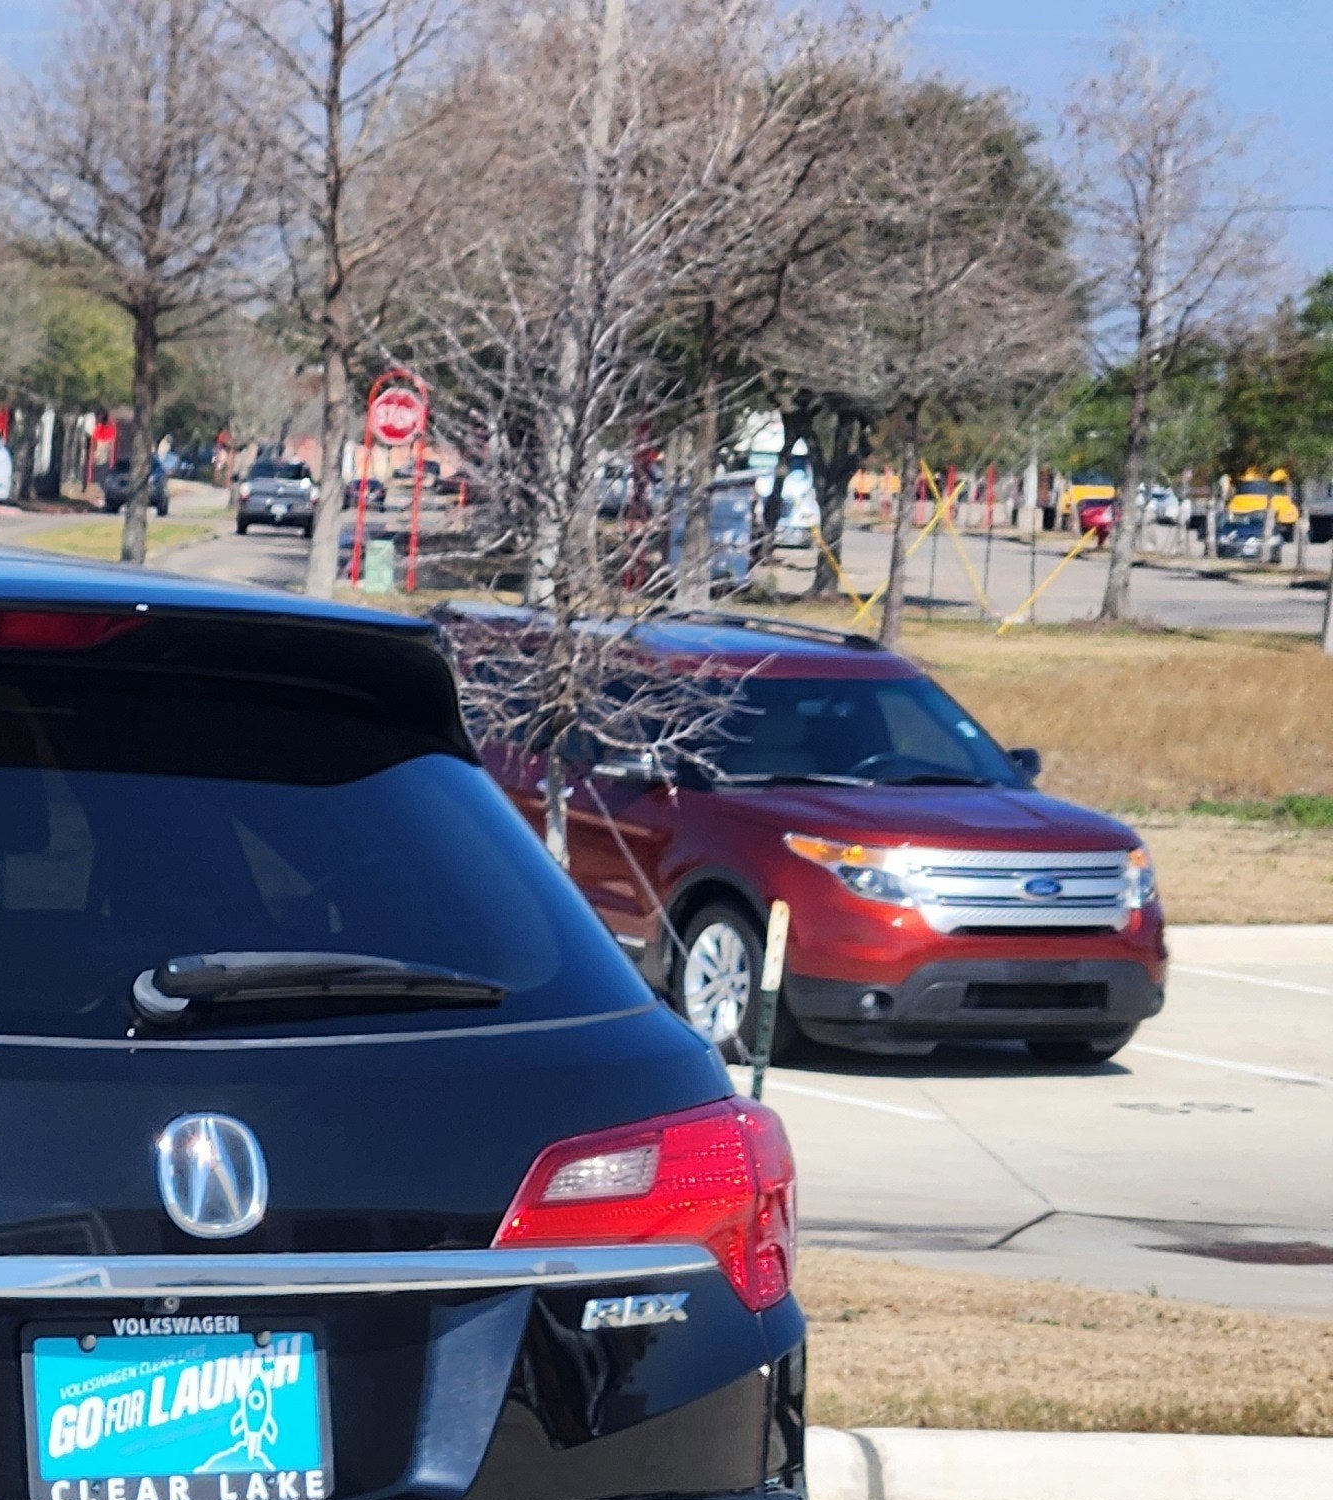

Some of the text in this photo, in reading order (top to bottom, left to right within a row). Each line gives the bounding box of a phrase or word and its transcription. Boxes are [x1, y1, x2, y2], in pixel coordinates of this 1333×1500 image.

[112, 1315, 240, 1336] VOLKSWAGEN
[581, 1290, 690, 1331] RDX
[48, 1334, 303, 1459] GO FOR LAUNCH
[60, 1366, 137, 1400] VOLKSWAGEN
[139, 1355, 176, 1376] CLEAR
